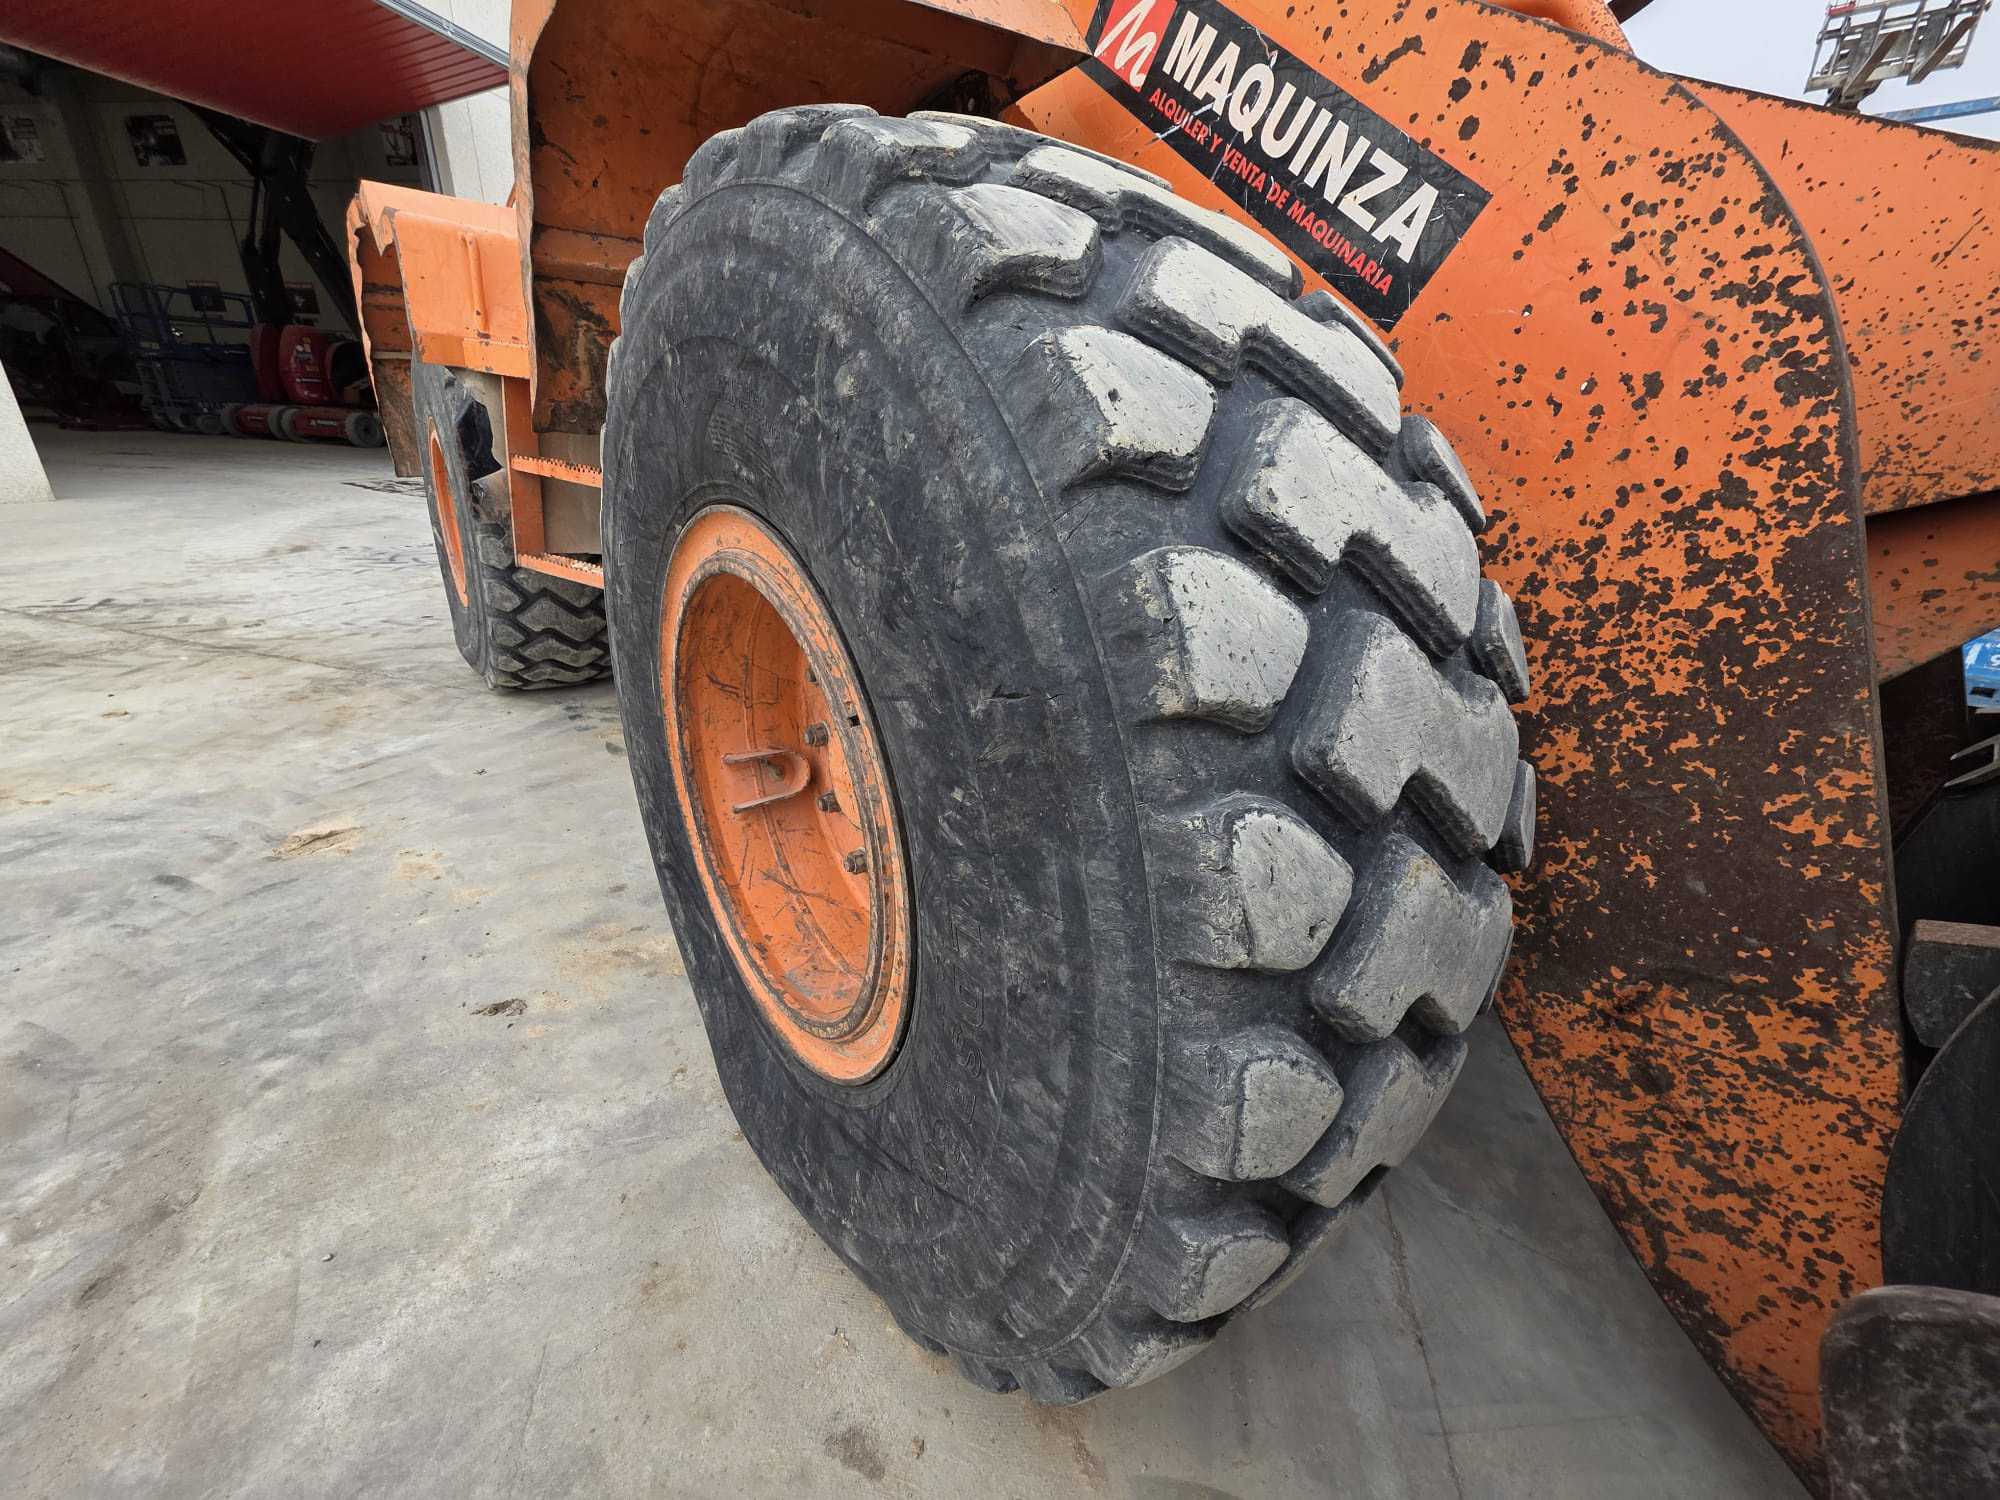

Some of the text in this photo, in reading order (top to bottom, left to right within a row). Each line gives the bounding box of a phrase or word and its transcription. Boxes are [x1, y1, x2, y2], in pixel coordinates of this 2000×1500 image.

[1149, 88, 1394, 296] ALQUILER Y VENTA DE MAQUINARIA
[1162, 10, 1440, 264] MAQUINZA
